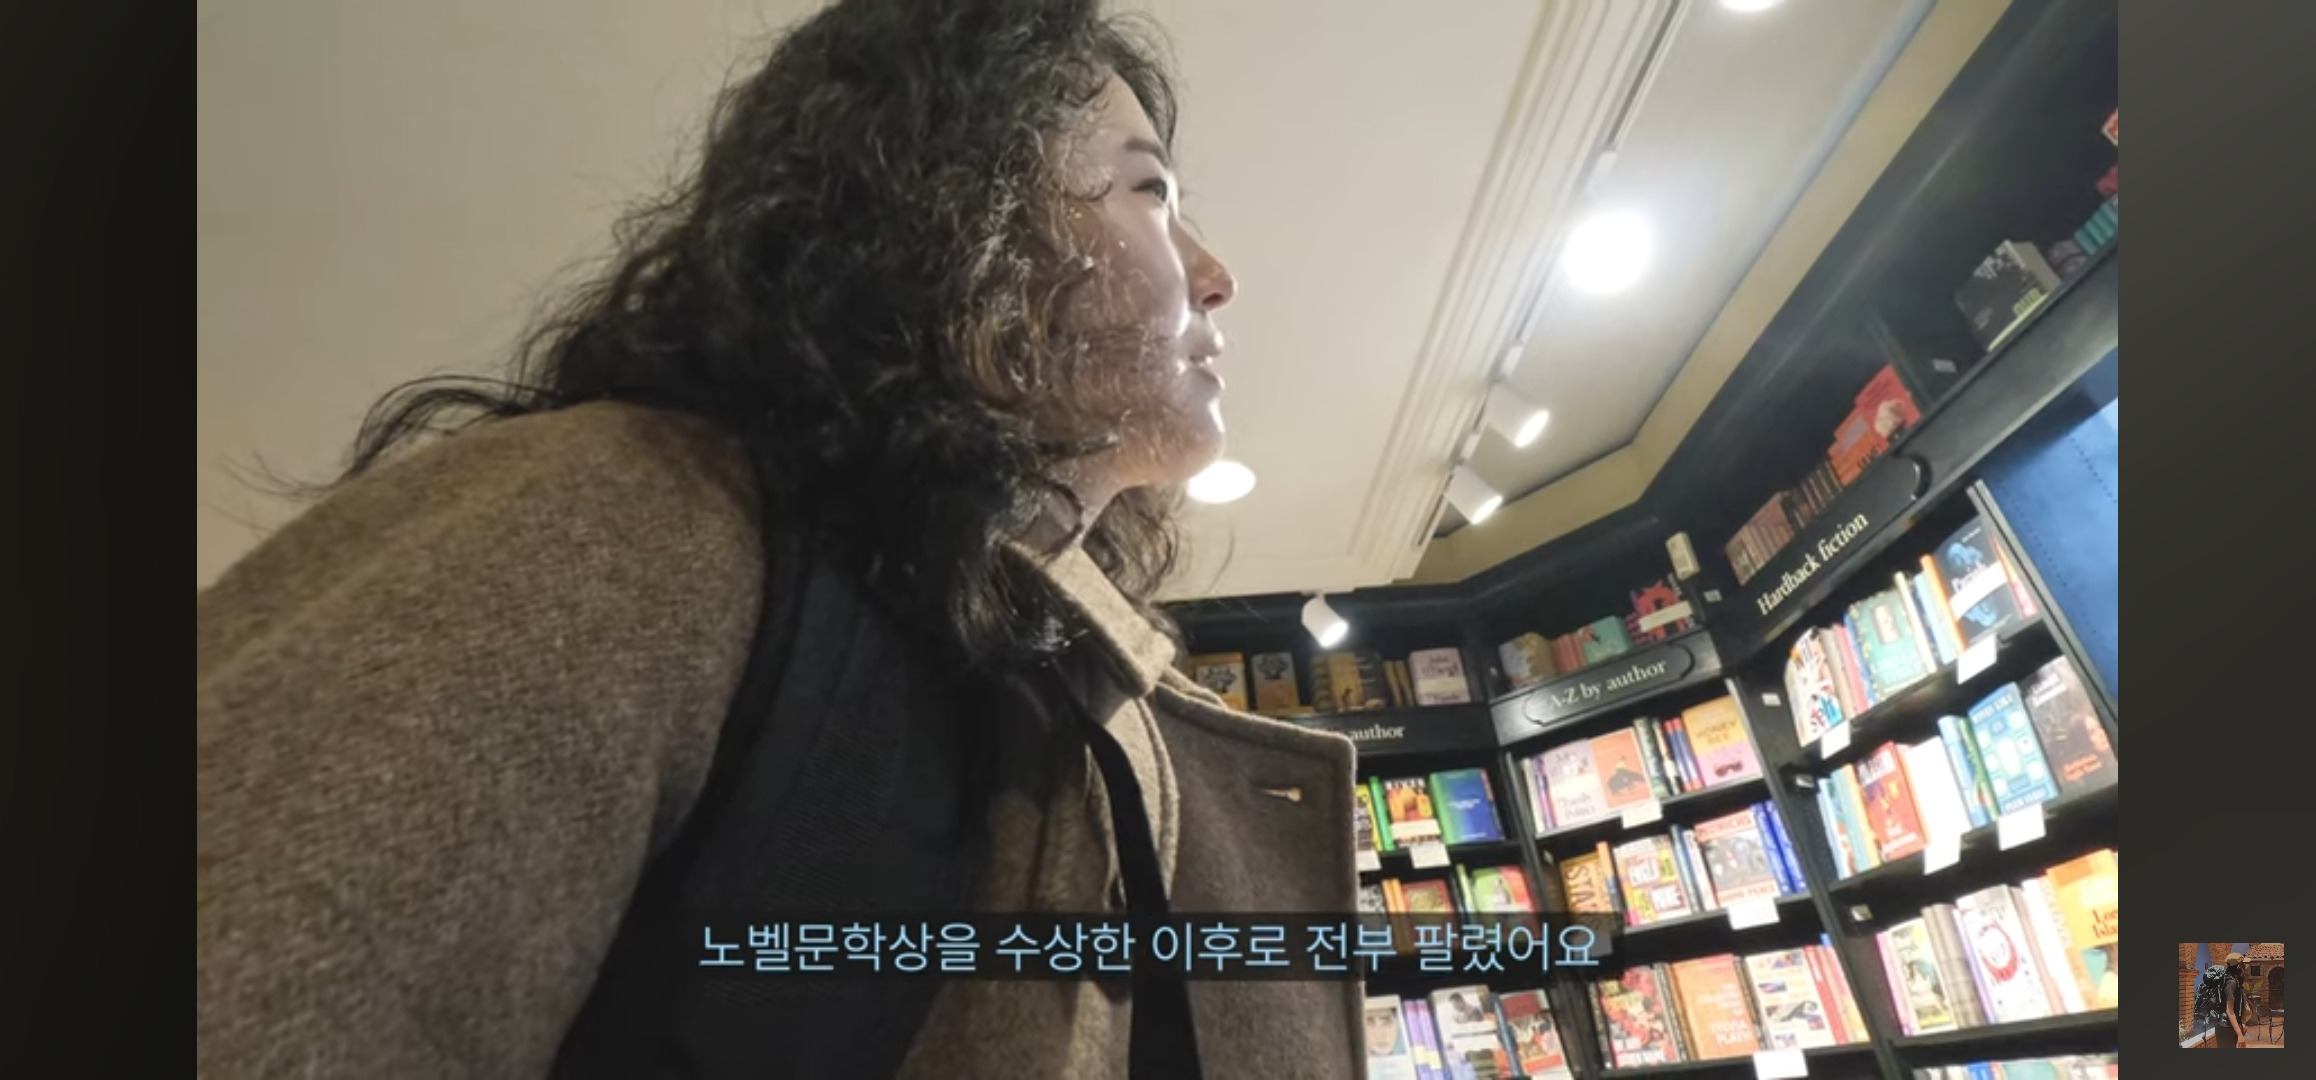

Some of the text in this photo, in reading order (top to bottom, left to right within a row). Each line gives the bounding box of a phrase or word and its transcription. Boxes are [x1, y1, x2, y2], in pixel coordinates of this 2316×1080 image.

[1757, 513, 1869, 616] Hardback fiction
[1580, 683, 1601, 700] by
[1606, 661, 1668, 692] author
[1350, 724, 1405, 741] author
